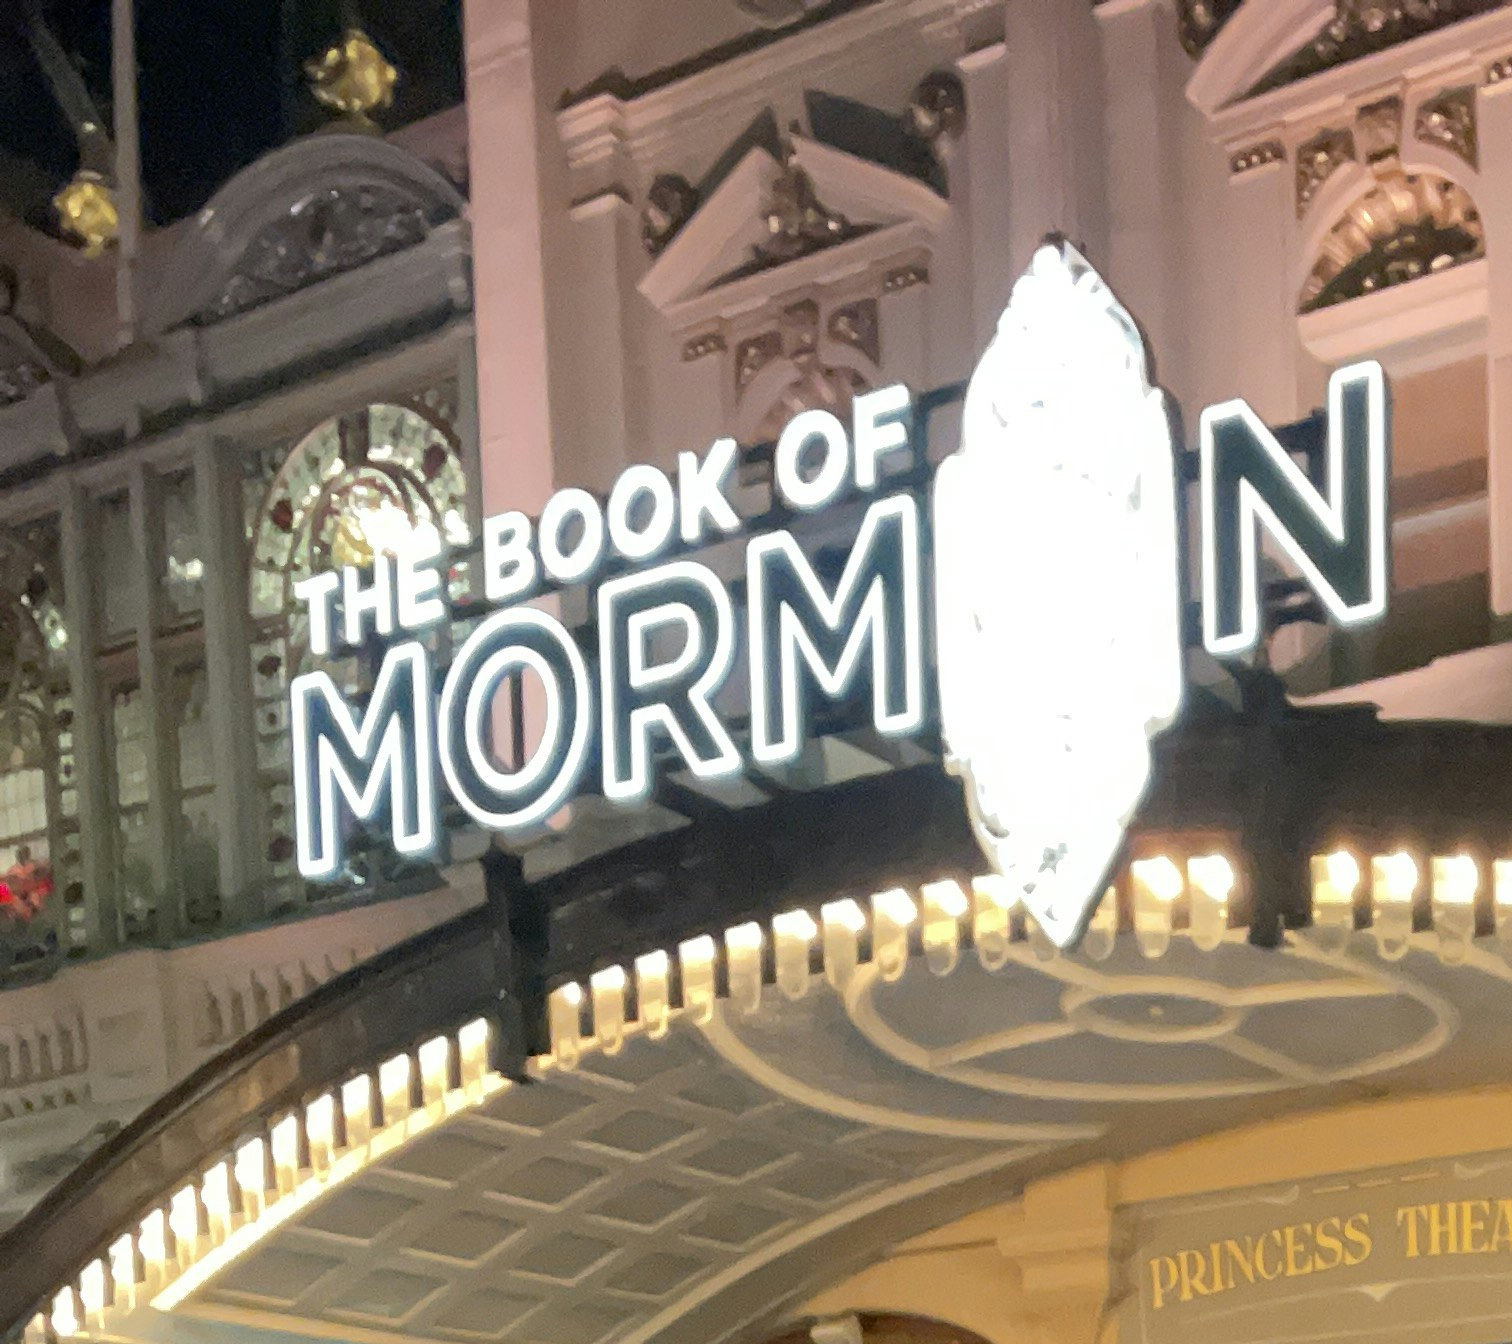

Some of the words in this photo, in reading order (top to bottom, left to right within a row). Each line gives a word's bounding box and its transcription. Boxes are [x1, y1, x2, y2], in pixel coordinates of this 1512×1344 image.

[293, 553, 451, 656] THE
[481, 437, 741, 604] BOOK
[775, 384, 912, 514] OF
[1149, 1211, 1375, 1309] PRINCESS
